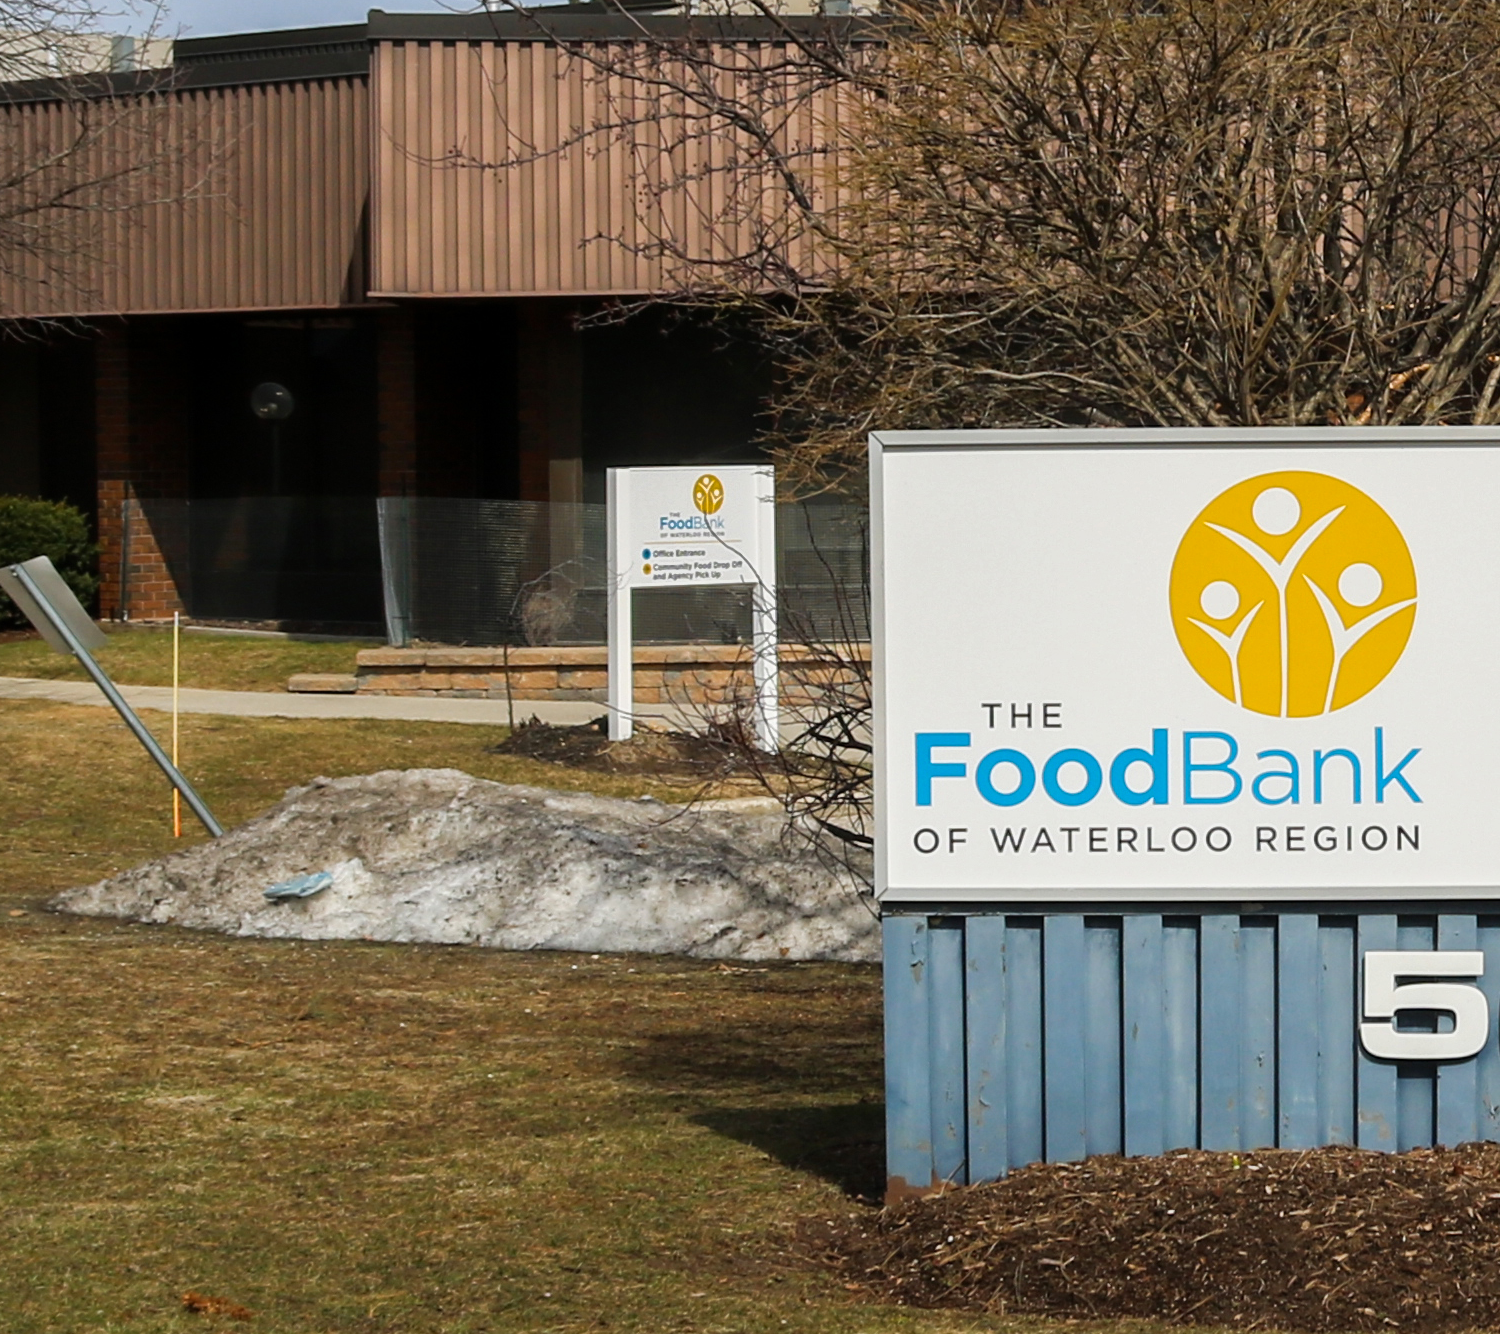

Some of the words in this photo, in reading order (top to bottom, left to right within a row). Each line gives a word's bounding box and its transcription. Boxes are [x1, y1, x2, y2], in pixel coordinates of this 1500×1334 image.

[676, 549, 706, 557] Entrance
[653, 563, 692, 571] Community
[713, 561, 730, 569] Drop
[667, 572, 693, 581] Agency
[695, 571, 709, 579] Pick
[711, 571, 721, 579] Up
[982, 703, 1062, 729] THE
[915, 727, 1422, 807] FoodBank
[914, 827, 967, 854] OF
[990, 826, 1231, 854] WATERLOO
[1257, 825, 1420, 853] REGION
